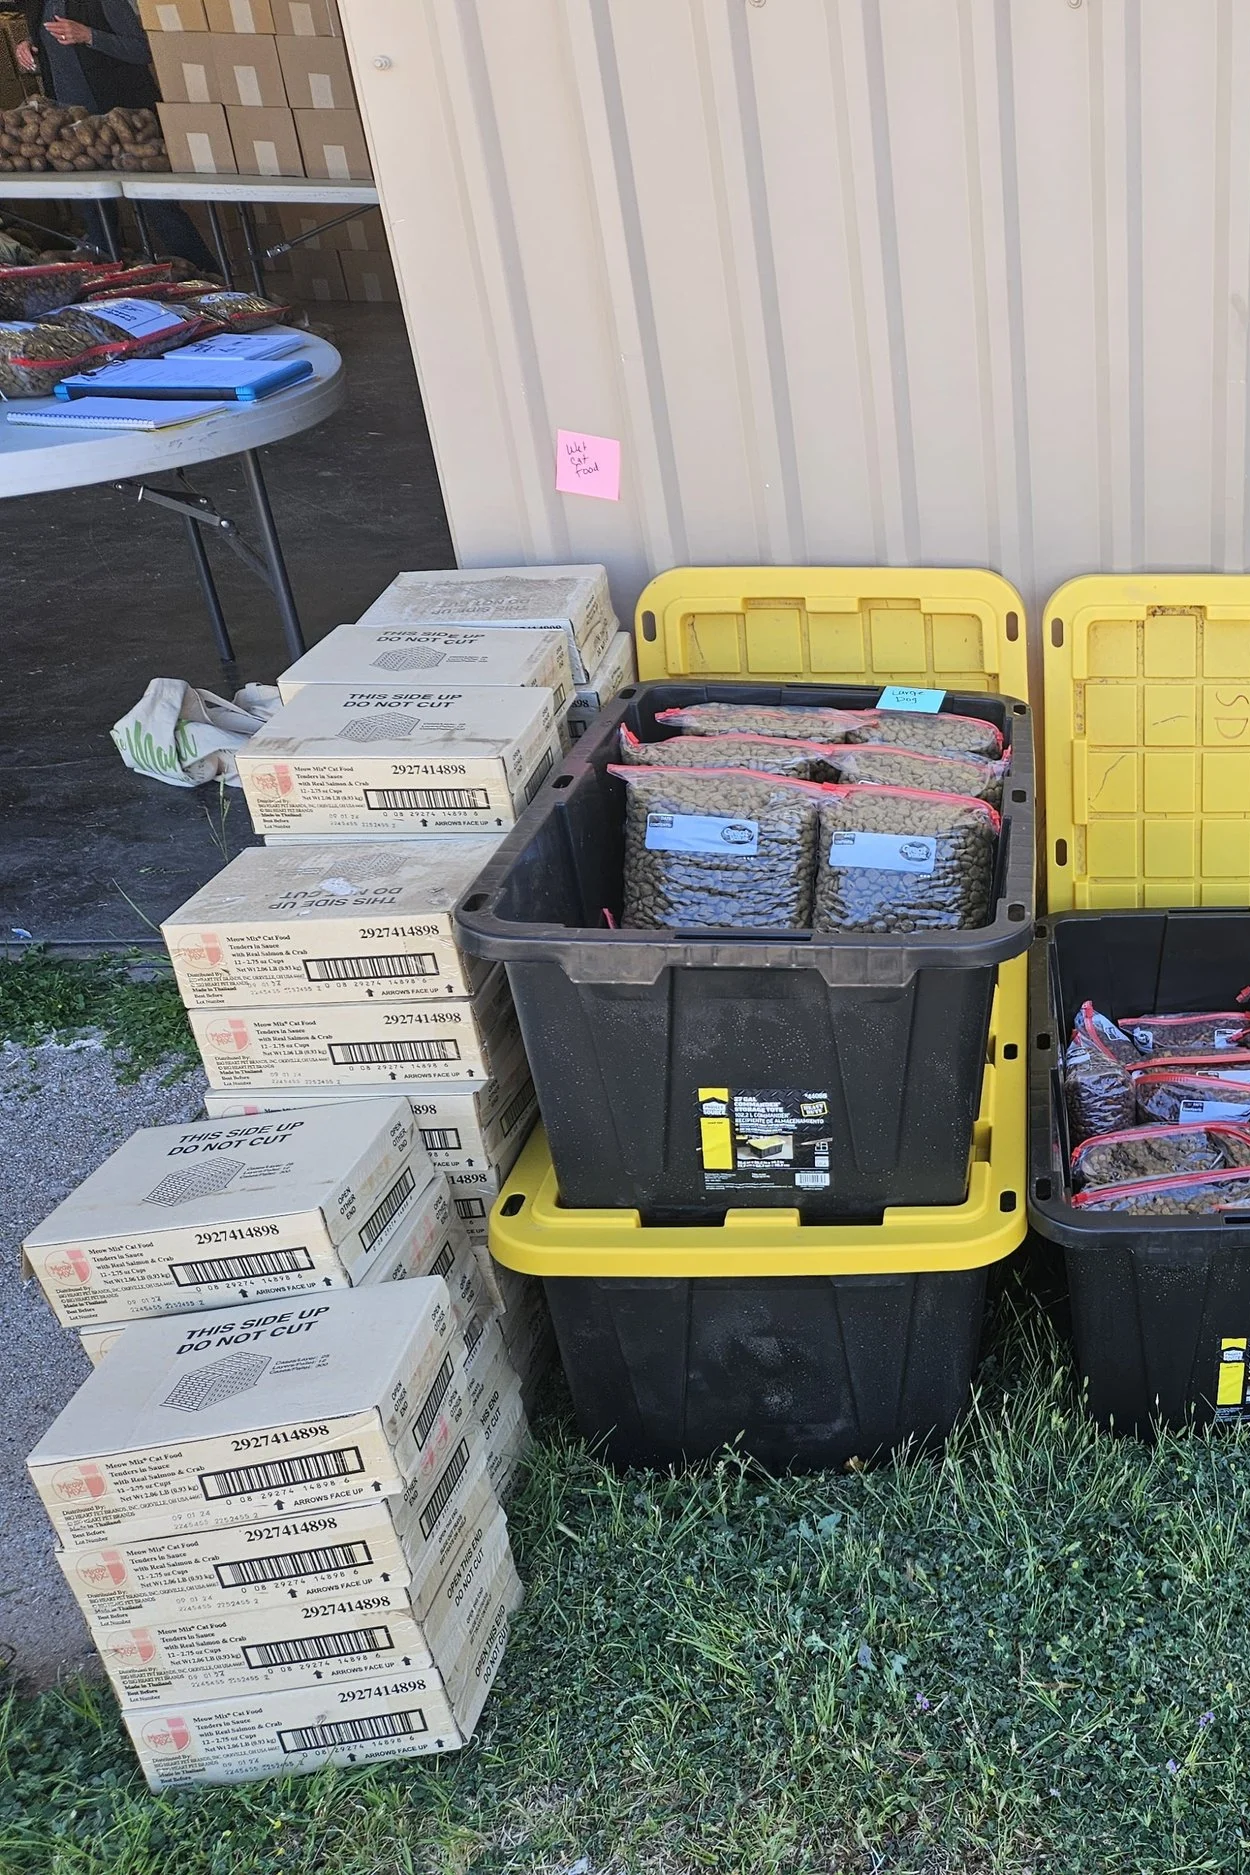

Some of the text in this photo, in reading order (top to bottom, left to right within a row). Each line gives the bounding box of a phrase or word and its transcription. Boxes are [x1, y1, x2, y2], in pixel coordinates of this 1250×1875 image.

[566, 441, 586, 455] Wet
[420, 631, 459, 639] SIDE
[391, 764, 466, 775] 2927414898
[279, 891, 318, 899] CUT
[373, 887, 403, 895] DO
[301, 898, 348, 907] SIDE
[359, 925, 440, 939] 2927414898
[383, 1013, 461, 1025] 2927414898
[179, 1121, 304, 1144] THIS SIDE UP
[390, 1120, 402, 1137] OPEN
[166, 1133, 292, 1156] DO NOT CUT
[398, 1139, 408, 1152] END
[338, 1186, 351, 1205] OPEN
[340, 1194, 356, 1216] OTHER
[346, 1206, 358, 1220] END
[194, 1224, 280, 1245] 2927414898
[256, 1286, 286, 1295] ARROWS
[288, 1284, 306, 1292] FACE
[186, 1306, 330, 1340] THIS SIDE UP
[176, 1320, 318, 1355] DO NOT CUT
[231, 1424, 330, 1451] 2927414898
[106, 1461, 128, 1469] Meow
[149, 1455, 162, 1464] Cat
[163, 1452, 183, 1462] Food
[109, 1469, 138, 1478] Tenders
[148, 1463, 170, 1471] Sauce
[113, 1478, 130, 1486] with
[132, 1476, 147, 1484] Real
[149, 1472, 176, 1482] Salmon
[186, 1465, 205, 1474] Crab
[57, 1479, 84, 1492] Meow
[155, 1480, 171, 1489] Cups
[240, 1495, 253, 1503] 08
[261, 1488, 294, 1500] 29274
[303, 1480, 336, 1491] 14898
[294, 1488, 364, 1506] ARROWS FACE UP
[87, 1529, 105, 1537] Before
[245, 1517, 338, 1542] 2927414898
[86, 1536, 108, 1544] Number
[447, 1570, 462, 1599] OPEN
[460, 1550, 473, 1574] THIS
[472, 1528, 483, 1550] END
[455, 1548, 485, 1607] DO NOT CUT
[306, 1578, 373, 1595] ARROWS FACE UP
[301, 1595, 391, 1619] 2927414898
[475, 1653, 489, 1677] OPEN
[486, 1630, 498, 1654] THIS
[495, 1605, 506, 1628] END
[484, 1625, 509, 1684] DO NOT CUT
[331, 1667, 363, 1676] ARROWS
[364, 1664, 383, 1672] FACE
[338, 1679, 427, 1703] 2927414898
